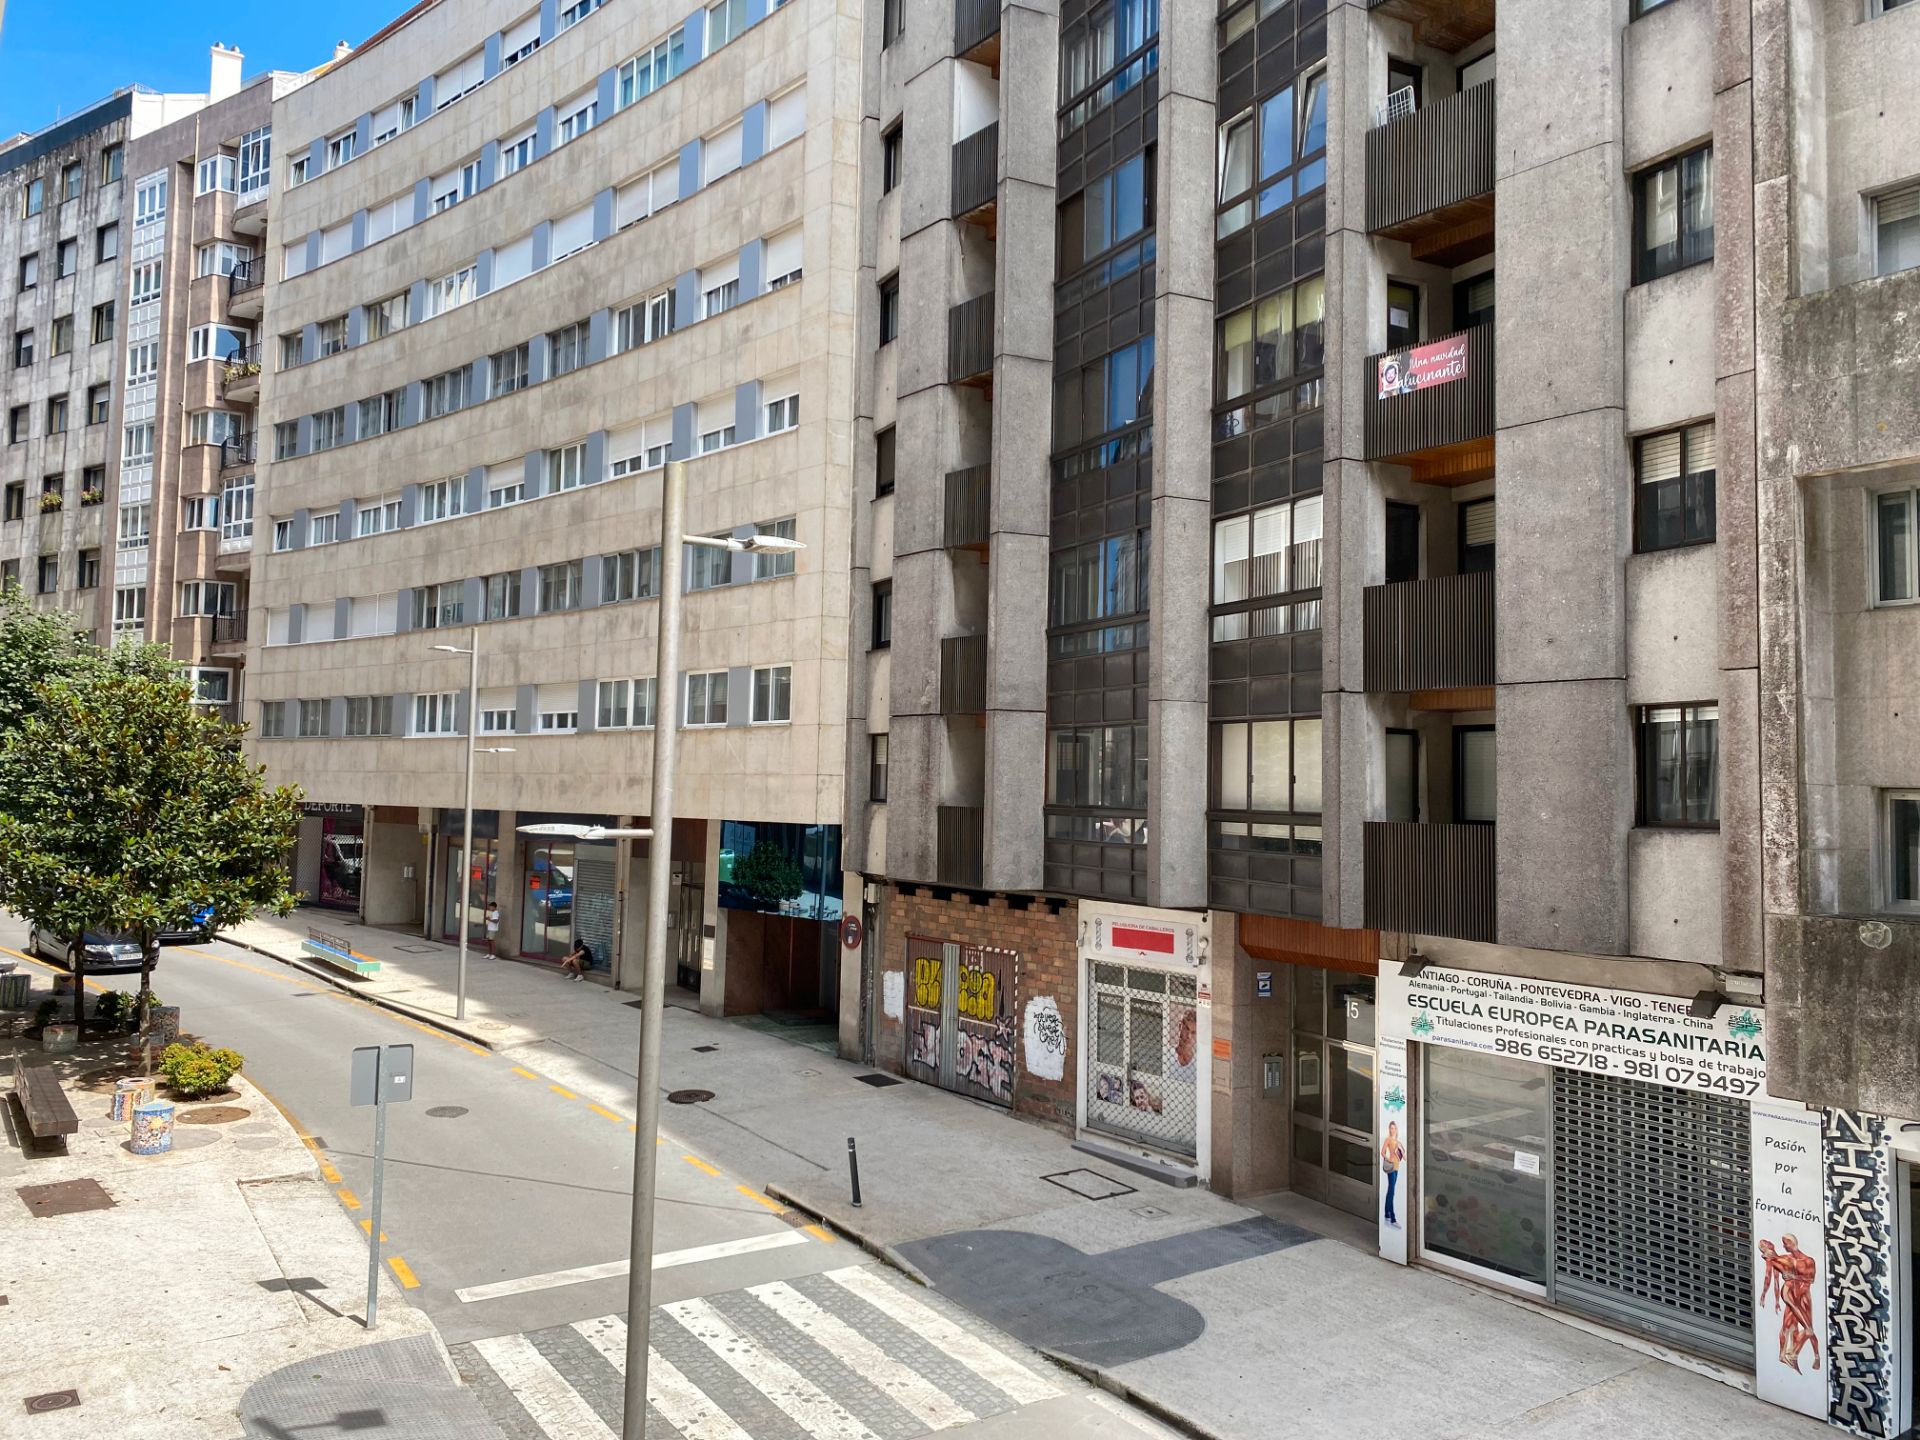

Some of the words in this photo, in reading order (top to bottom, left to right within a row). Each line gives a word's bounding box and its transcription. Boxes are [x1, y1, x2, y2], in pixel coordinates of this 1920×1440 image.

[1430, 343, 1466, 363] navidad
[1398, 357, 1466, 389] alucinante!
[304, 802, 352, 812] DEPORTE
[1418, 970, 1460, 984] ANTIAGO
[1467, 976, 1512, 992] CORUÑA
[1520, 983, 1601, 1003] PONTEVEDRA
[1610, 995, 1641, 1009] VIGO
[1347, 1000, 1359, 1019] 15
[1408, 980, 1445, 992] Alemania
[1451, 985, 1487, 999] Portugal
[1493, 991, 1534, 1005] Tailandia
[1541, 998, 1572, 1010] Bolivia
[1580, 1004, 1615, 1016] Gambia
[1623, 1009, 1675, 1025] Inglaterra
[1683, 1018, 1714, 1030] China
[1408, 993, 1483, 1018] ESCUELA
[1488, 1006, 1578, 1033] EUROPEA
[1584, 1020, 1765, 1061] PARASANITARIA
[1431, 1035, 1493, 1051] parasanitaria.com
[1436, 1016, 1493, 1033] Titulaciones
[1495, 1025, 1566, 1045] Profesionales
[1570, 1039, 1589, 1049] con
[1592, 1043, 1646, 1058] practicas
[1649, 1052, 1657, 1061] y
[1661, 1051, 1694, 1066] bolsa
[1698, 1059, 1713, 1070] de
[1717, 1061, 1766, 1079] trabajo
[1494, 1038, 1532, 1057] 986
[1537, 1045, 1608, 1070] 652718
[1624, 1060, 1658, 1079] 981
[1665, 1067, 1760, 1096] 079497
[1765, 1136, 1807, 1153] Pasión
[1774, 1162, 1798, 1174] por
[1781, 1182, 1792, 1195] la
[1755, 1198, 1821, 1223] formación
